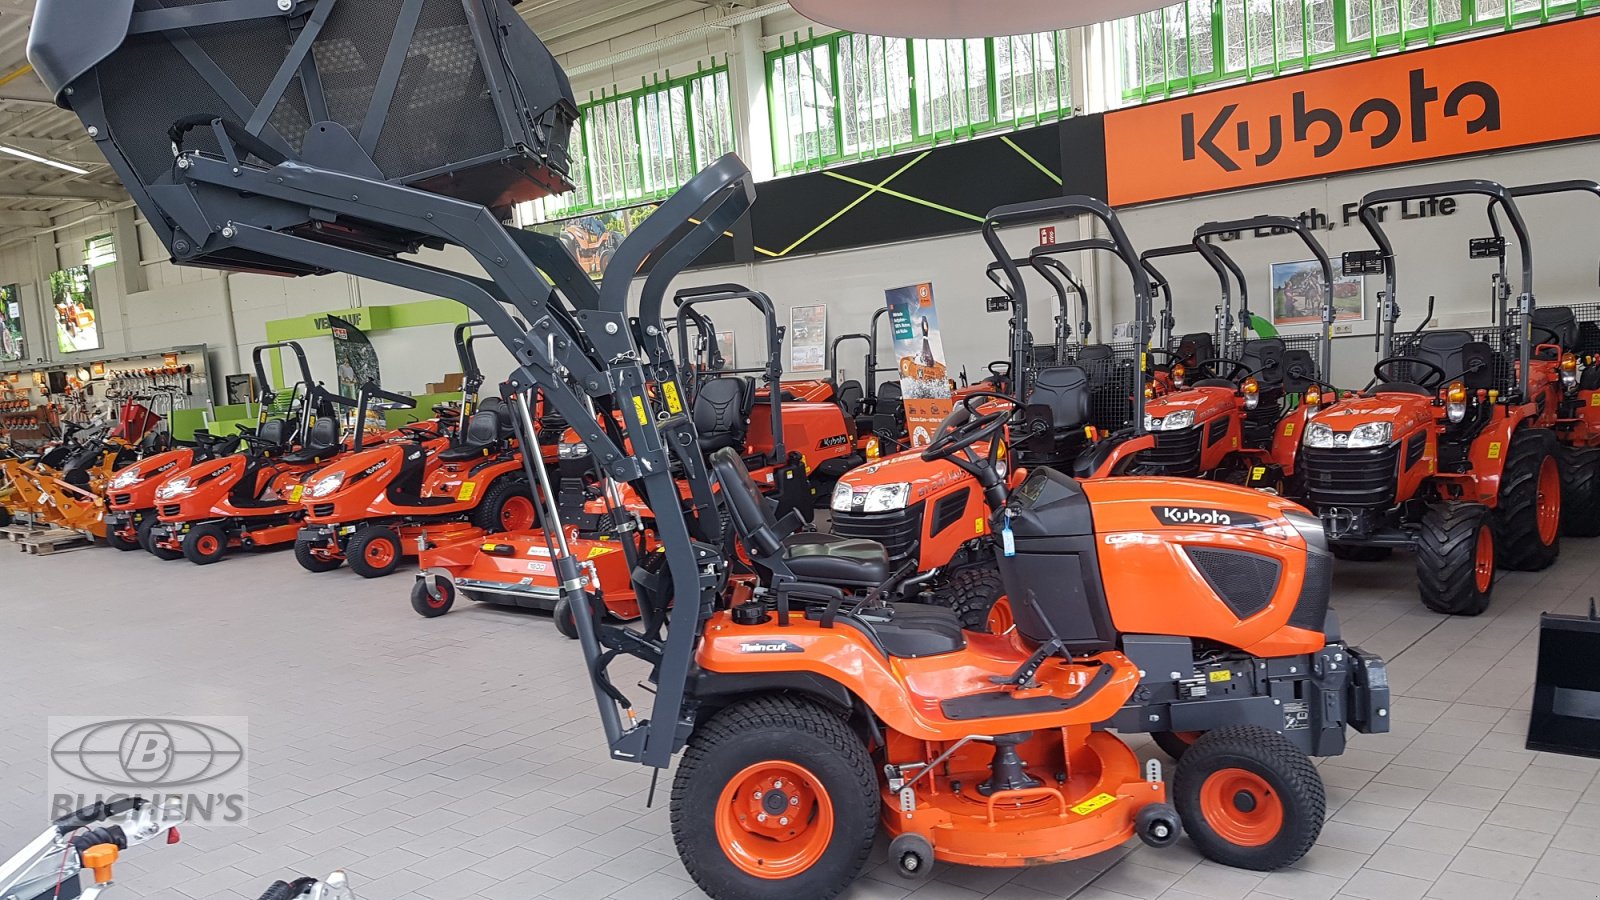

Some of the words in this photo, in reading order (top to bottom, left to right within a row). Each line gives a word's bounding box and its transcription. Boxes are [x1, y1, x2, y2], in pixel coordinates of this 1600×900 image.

[1181, 68, 1502, 172] Kubota
[1401, 196, 1457, 220] Life
[313, 312, 362, 330] VEAUF
[824, 435, 846, 446] Kubota
[1164, 507, 1231, 525] Kubota
